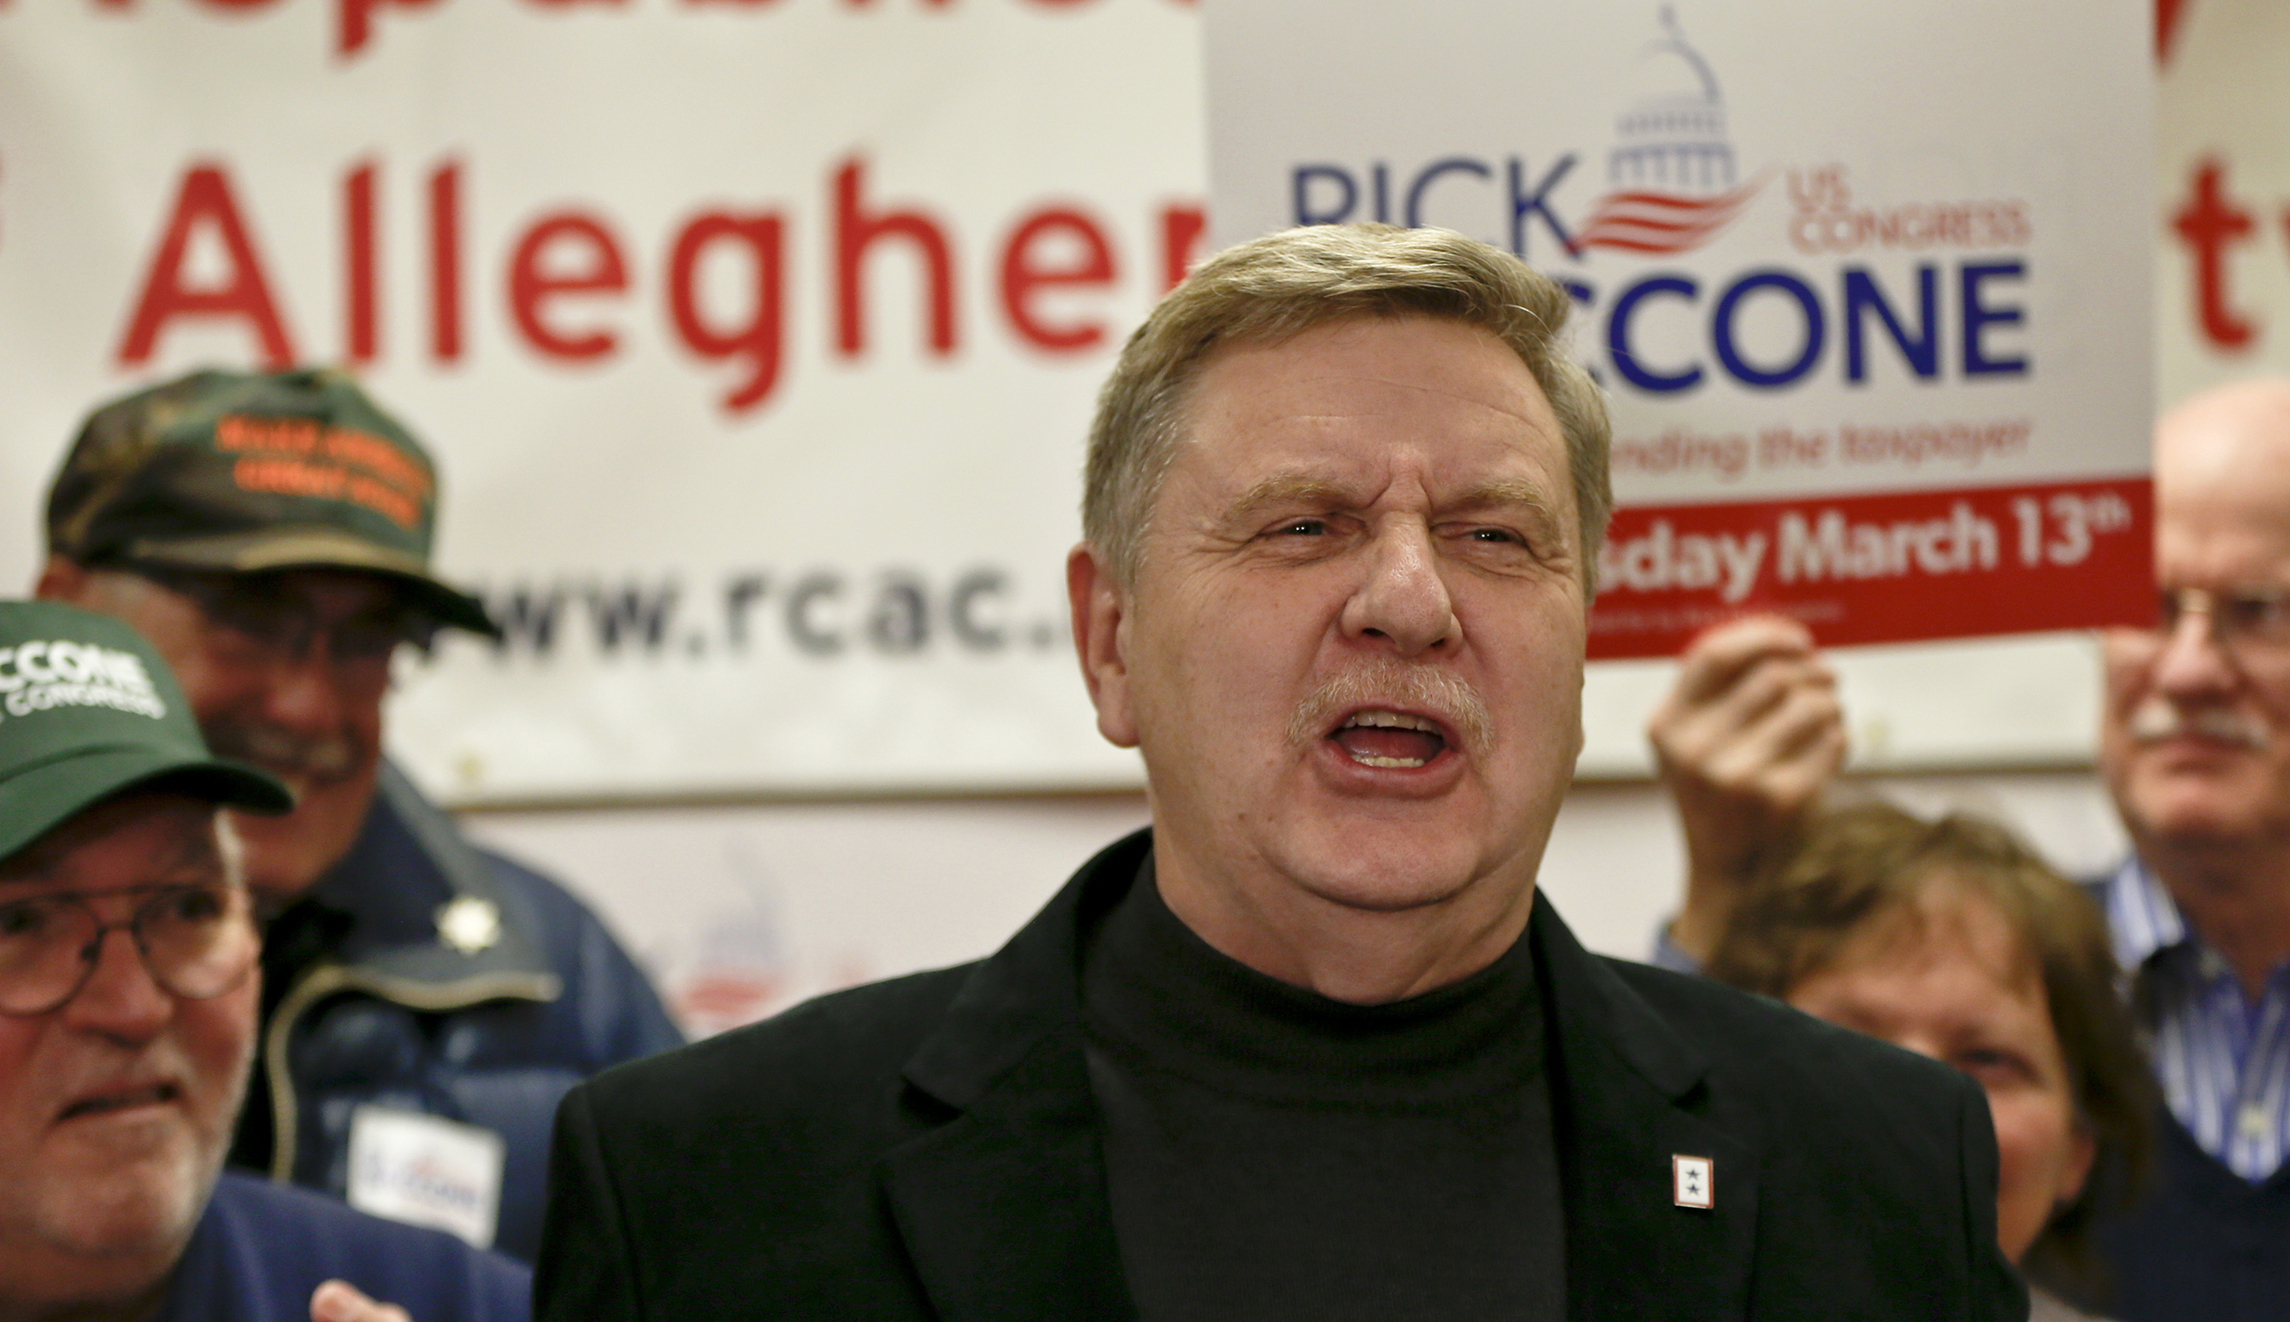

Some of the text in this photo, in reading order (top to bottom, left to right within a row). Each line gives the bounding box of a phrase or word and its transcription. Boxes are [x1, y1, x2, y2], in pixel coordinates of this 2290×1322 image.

[1786, 162, 1850, 215] US
[1789, 200, 2033, 255] CONGRESS
[1552, 258, 2032, 394] CONE
[1755, 421, 1829, 470] the
[1837, 416, 2033, 470] taxpayer
[1778, 502, 1996, 583] March
